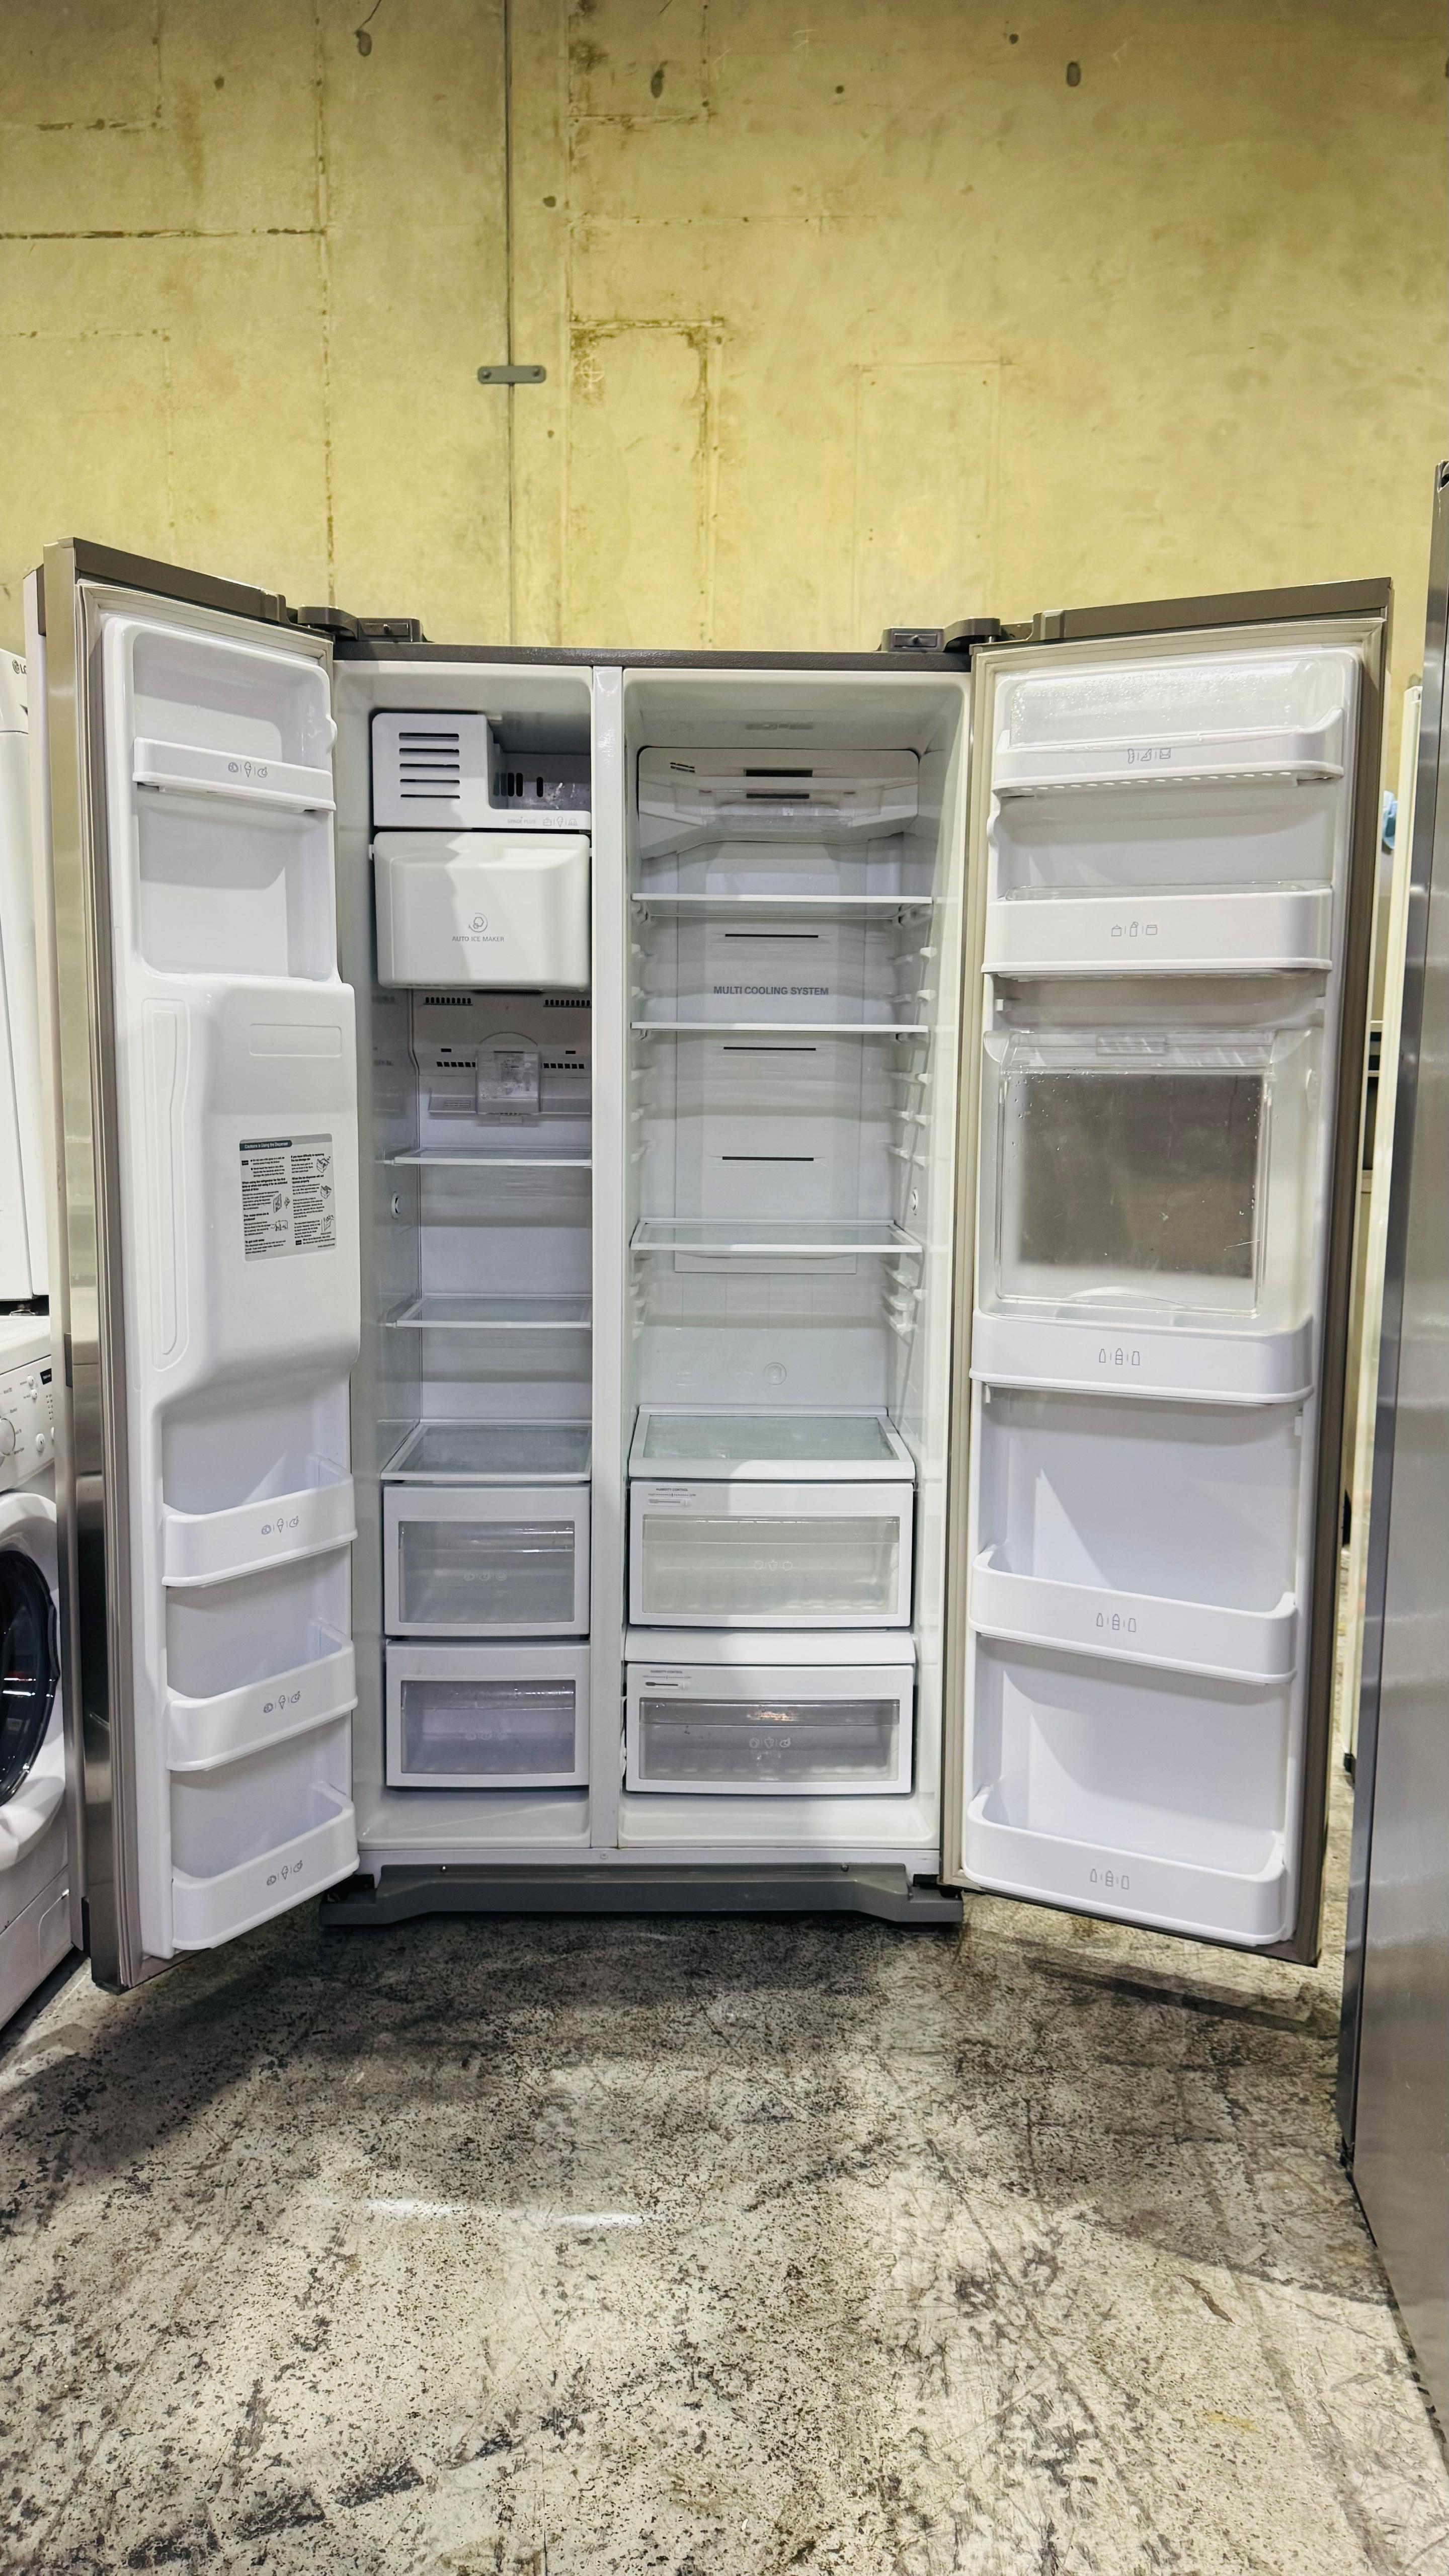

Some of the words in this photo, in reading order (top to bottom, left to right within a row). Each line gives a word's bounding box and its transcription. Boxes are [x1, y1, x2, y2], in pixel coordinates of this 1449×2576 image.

[713, 986, 742, 994] MULTI
[745, 987, 788, 995] COOLING
[790, 987, 829, 995] SYSTEM
